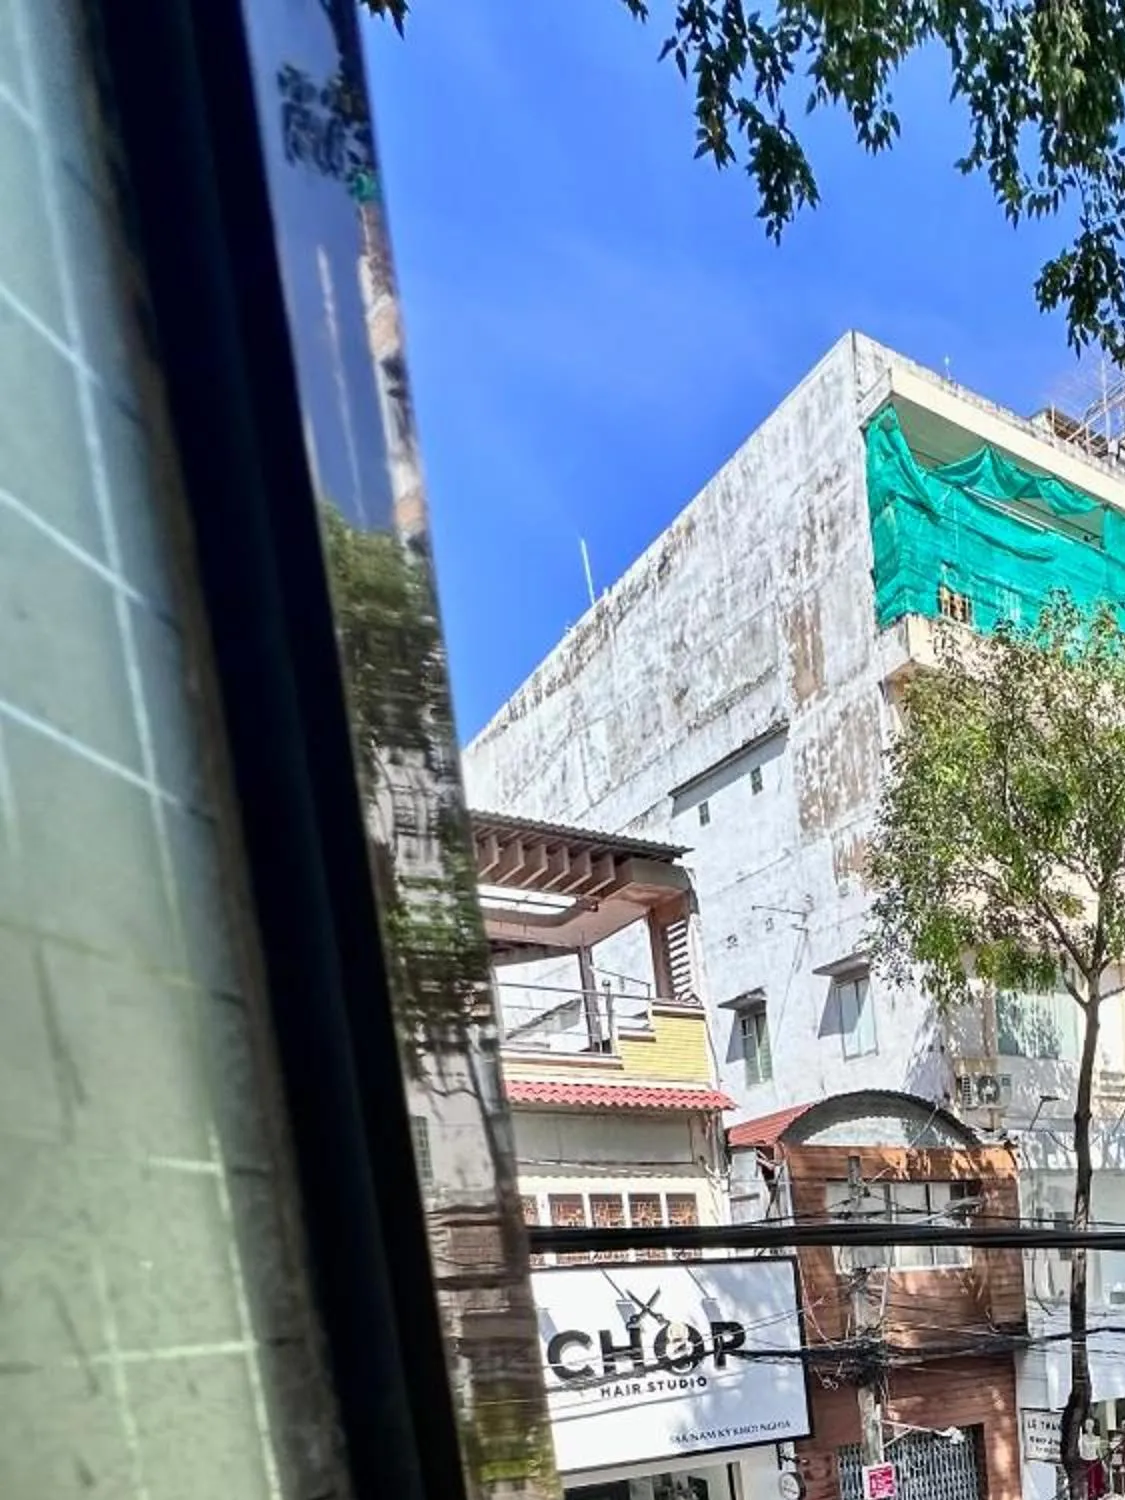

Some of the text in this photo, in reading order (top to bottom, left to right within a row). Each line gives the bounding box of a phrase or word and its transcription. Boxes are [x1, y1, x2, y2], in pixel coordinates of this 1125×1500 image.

[547, 1321, 746, 1381] CHOP
[600, 1376, 707, 1398] HAIR STUDIO
